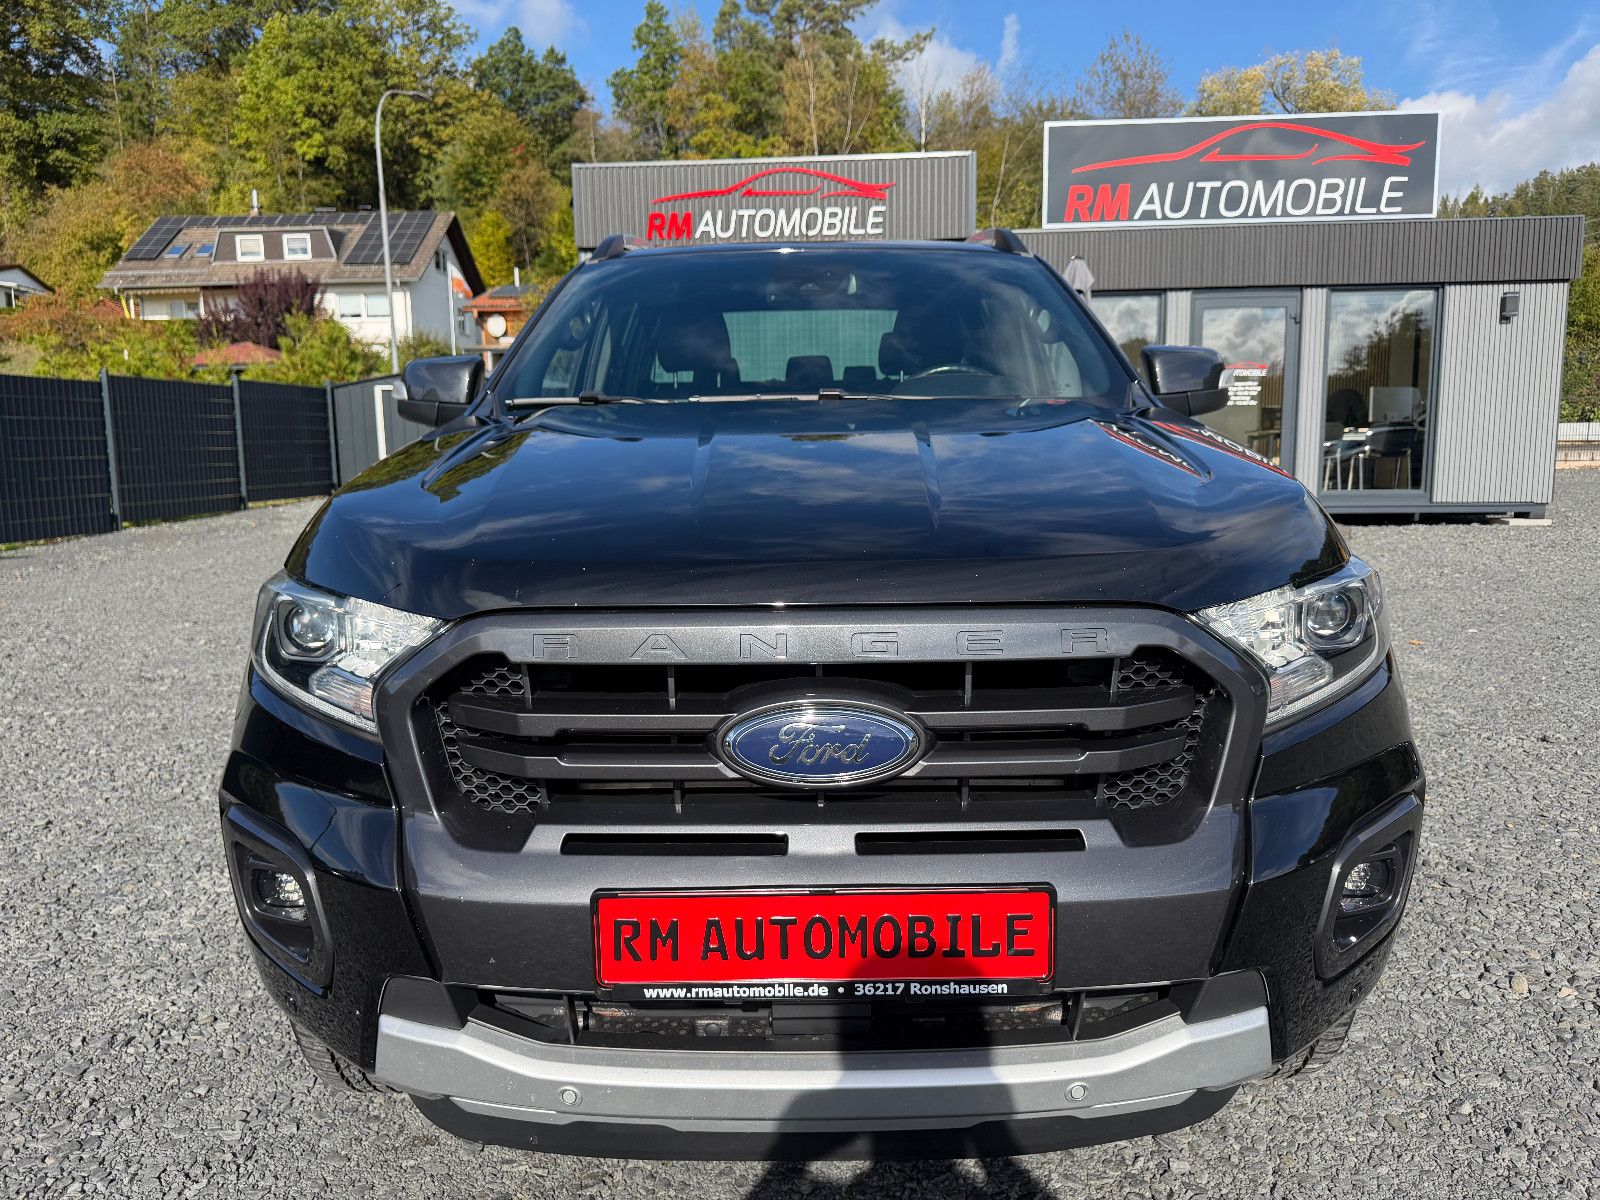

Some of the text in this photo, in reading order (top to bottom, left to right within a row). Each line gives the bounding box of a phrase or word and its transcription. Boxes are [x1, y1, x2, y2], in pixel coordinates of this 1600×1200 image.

[1064, 176, 1409, 222] RM AUTOMOBILE
[646, 205, 887, 240] RM AUTOMOBILE
[532, 627, 1109, 660] RANGER
[768, 722, 872, 766] Ford
[613, 913, 1035, 962] RM AUTOMOBILE
[643, 981, 1008, 999] www.rmautomobile.de 36217 Ronshausen
